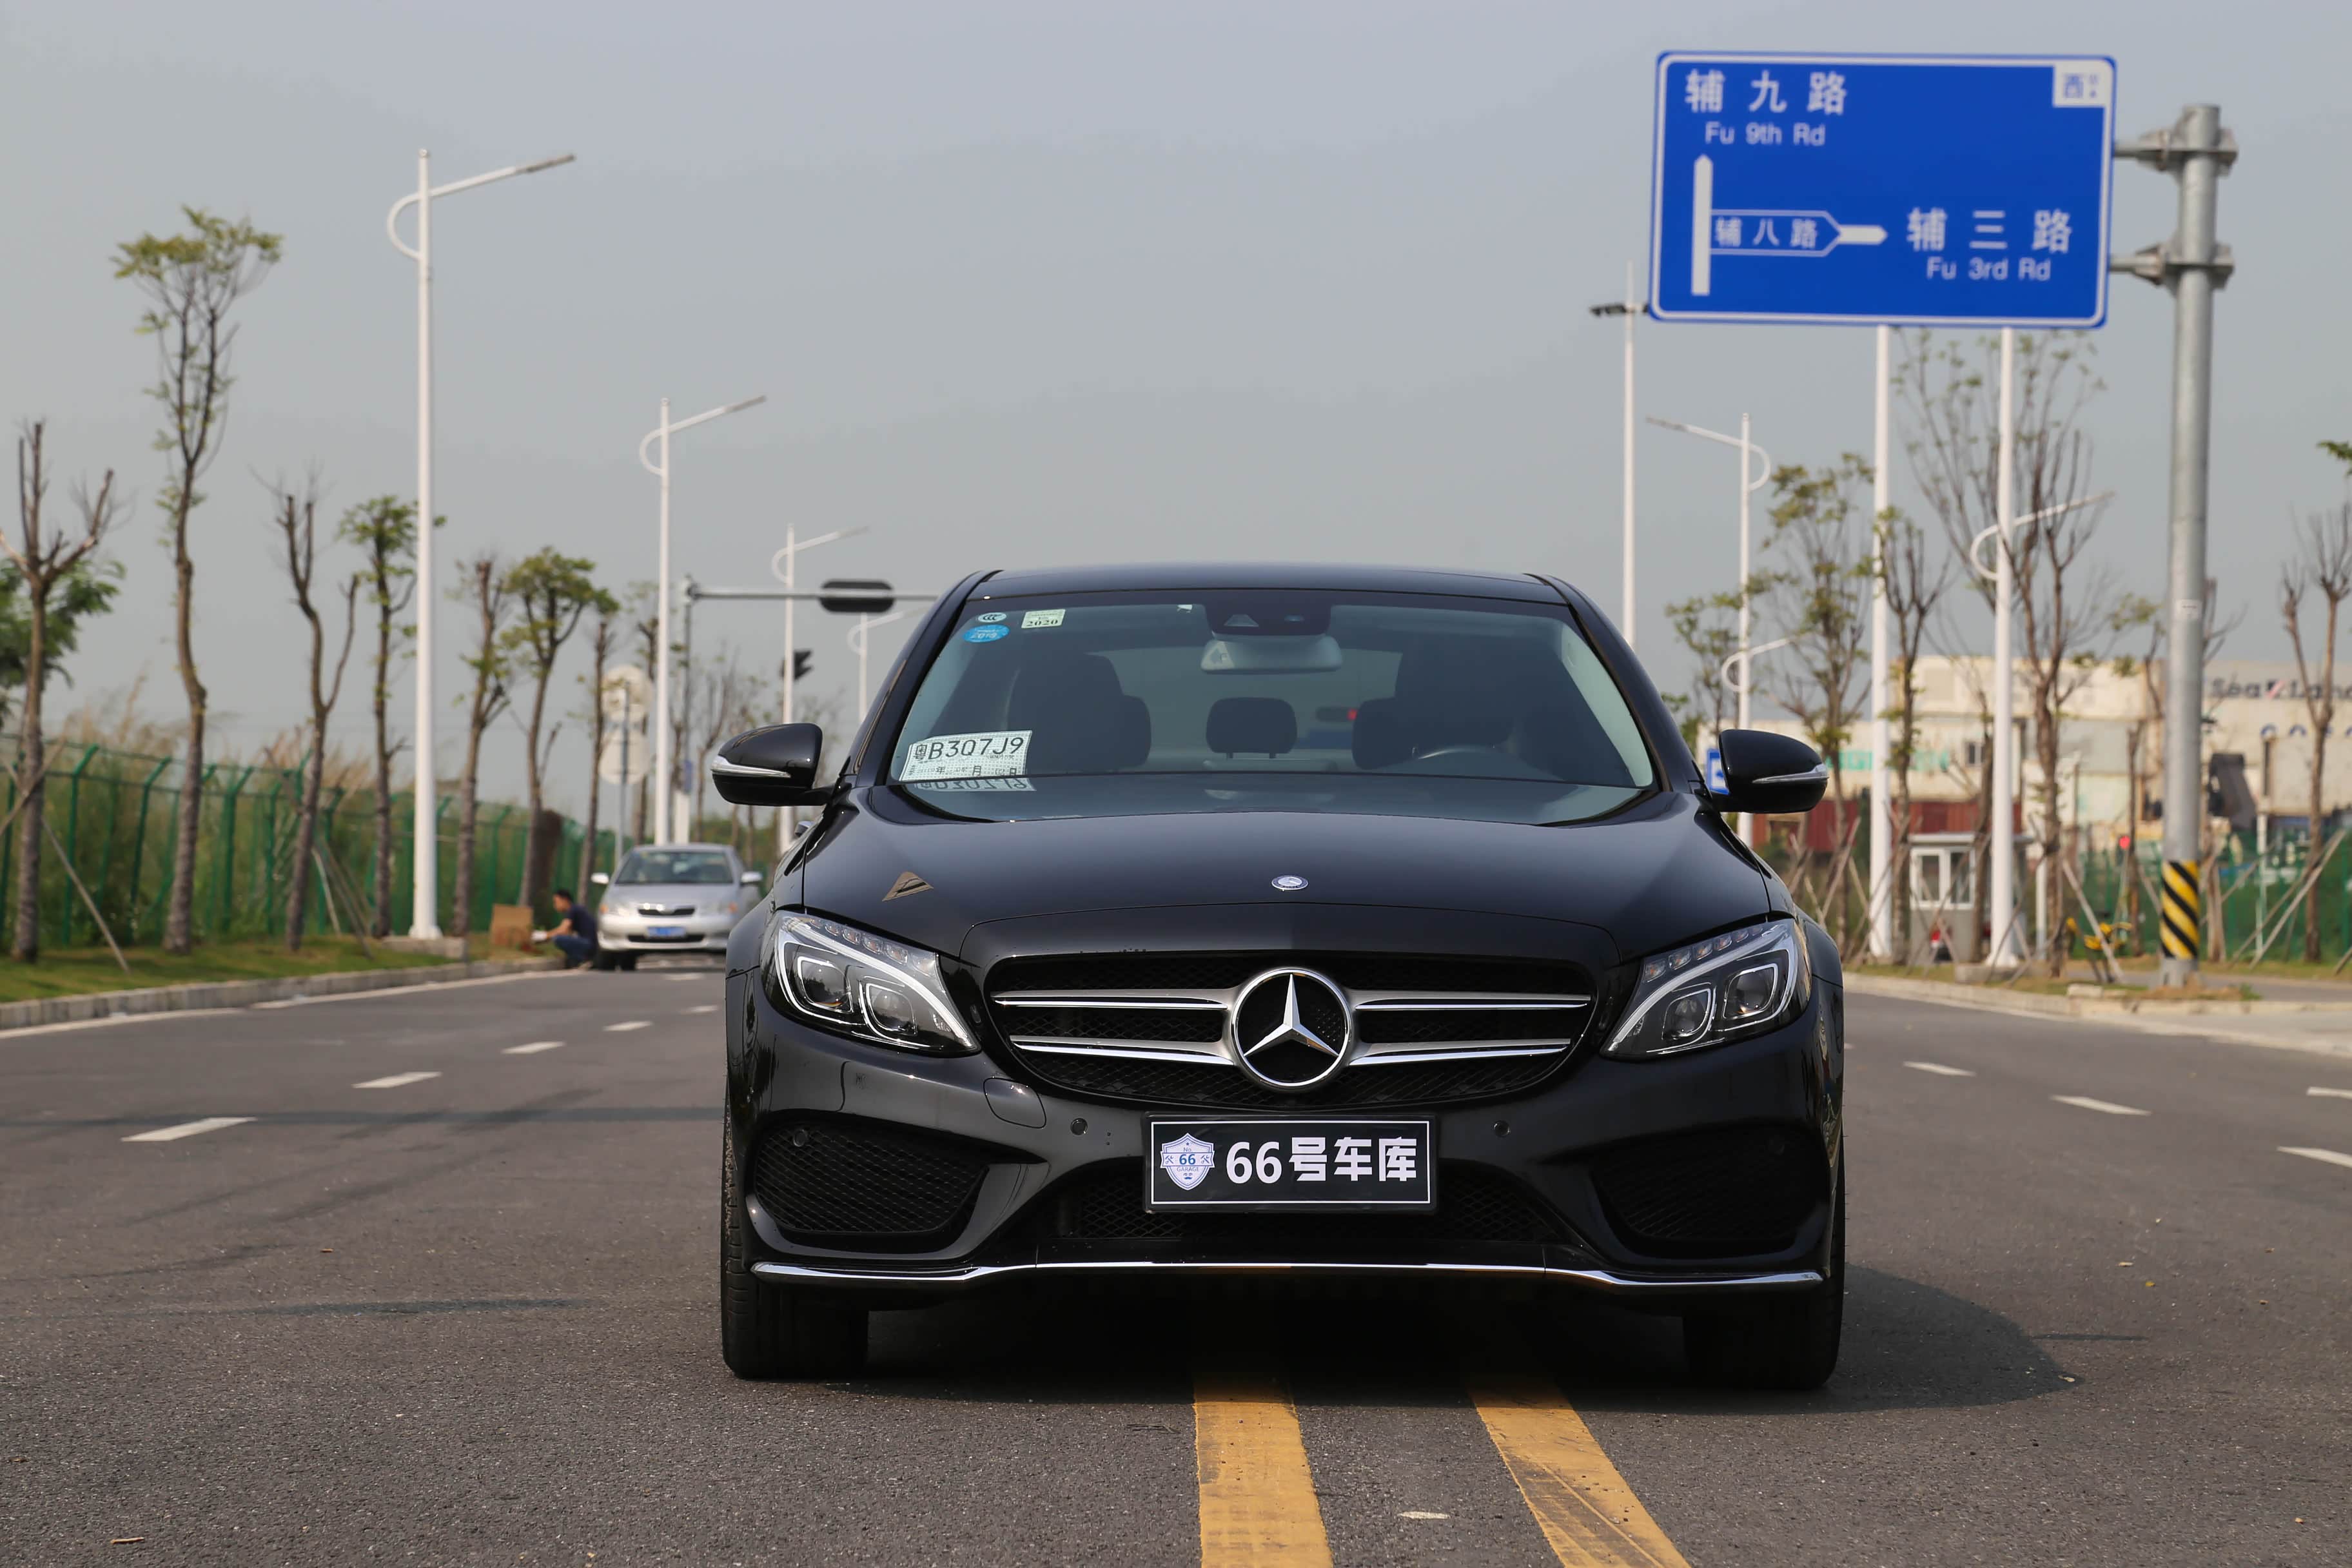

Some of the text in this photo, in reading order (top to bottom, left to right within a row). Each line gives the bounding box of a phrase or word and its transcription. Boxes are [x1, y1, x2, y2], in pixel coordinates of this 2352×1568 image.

[1685, 68, 1847, 115] 辅九路
[1705, 122, 1826, 146] Fu 9th Rd
[1715, 218, 1818, 249] 辅八路
[1906, 207, 2072, 253] 辅三路
[1926, 257, 2052, 280] Fu 3rd Rd
[1179, 1153, 1196, 1165] 66
[1226, 1136, 1417, 1184] 66号车库
